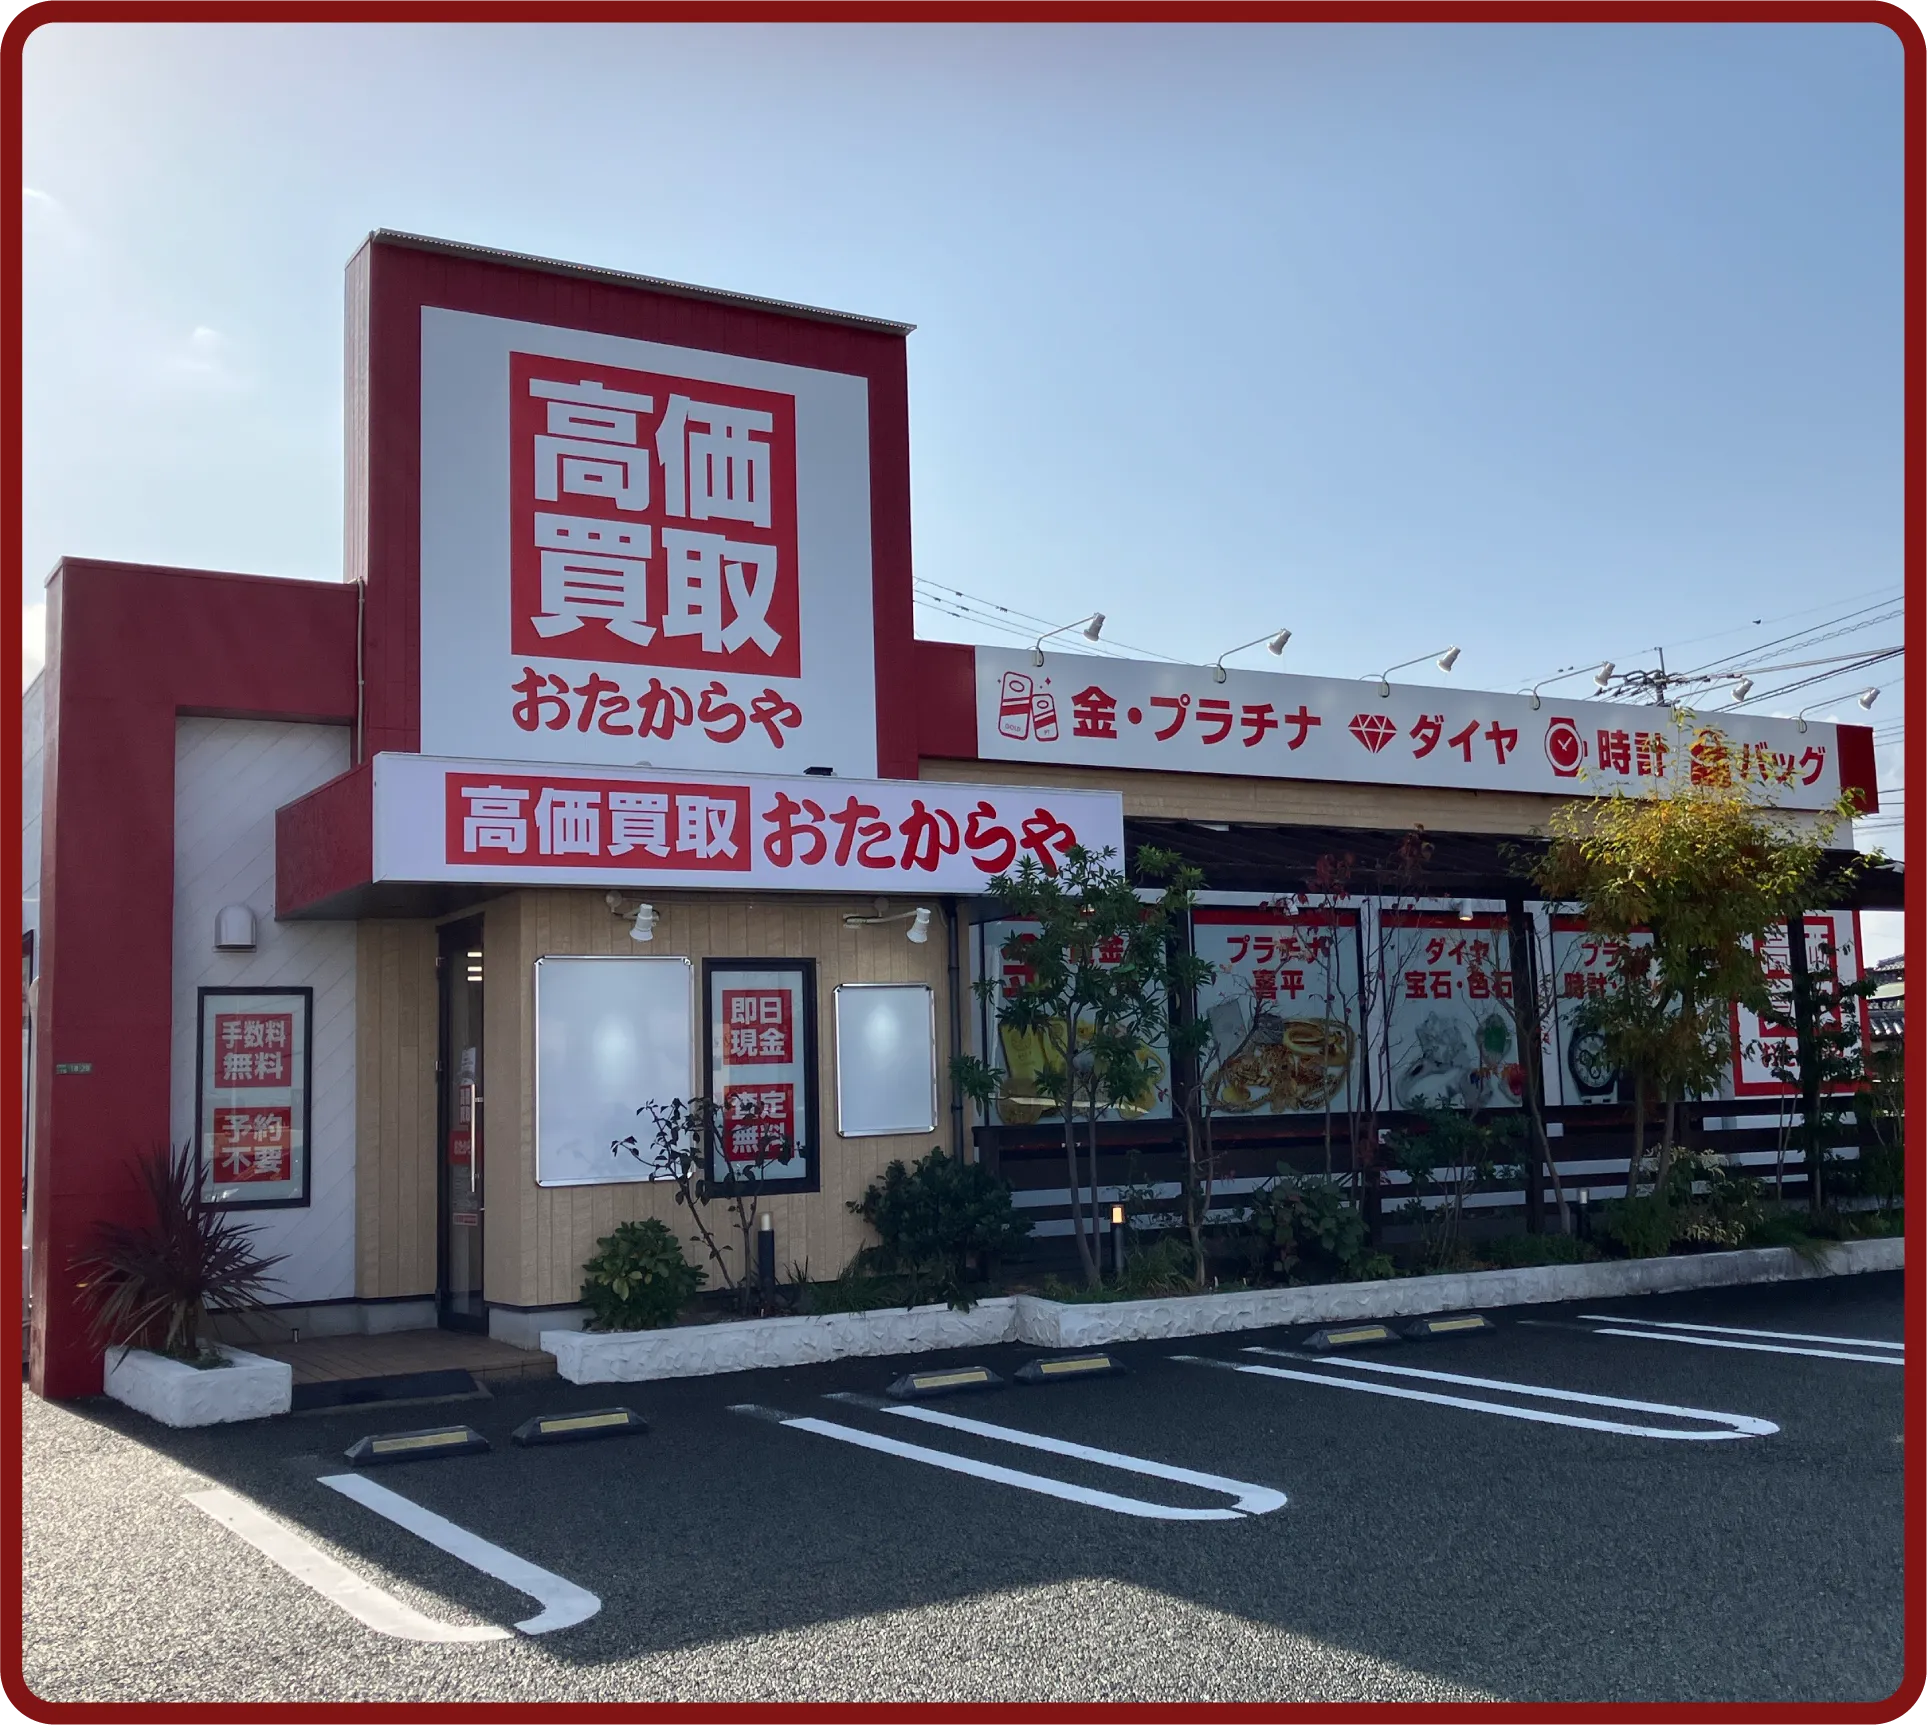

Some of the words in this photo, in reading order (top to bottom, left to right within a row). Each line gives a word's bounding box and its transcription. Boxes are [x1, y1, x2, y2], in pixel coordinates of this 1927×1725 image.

[529, 377, 774, 529] 高価
[530, 510, 783, 658] 買取
[511, 666, 803, 750] おたからや
[1004, 723, 1022, 732] GOLD
[1071, 685, 1322, 751] 金・プラチナ
[1409, 714, 1519, 765] ダイヤ
[1596, 729, 1666, 778] 時計
[461, 784, 740, 860] 高価買取
[762, 791, 1078, 877] おたからや
[1226, 934, 1333, 964] プラチナ
[1425, 936, 1490, 965] ダイヤ
[1251, 969, 1305, 1000] 喜平
[730, 997, 783, 1025] 即日
[221, 1020, 287, 1049] 手数料
[730, 1027, 785, 1057] 現金
[223, 1051, 284, 1081] 無料
[222, 1113, 283, 1143] 予約
[221, 1145, 283, 1175] 不要
